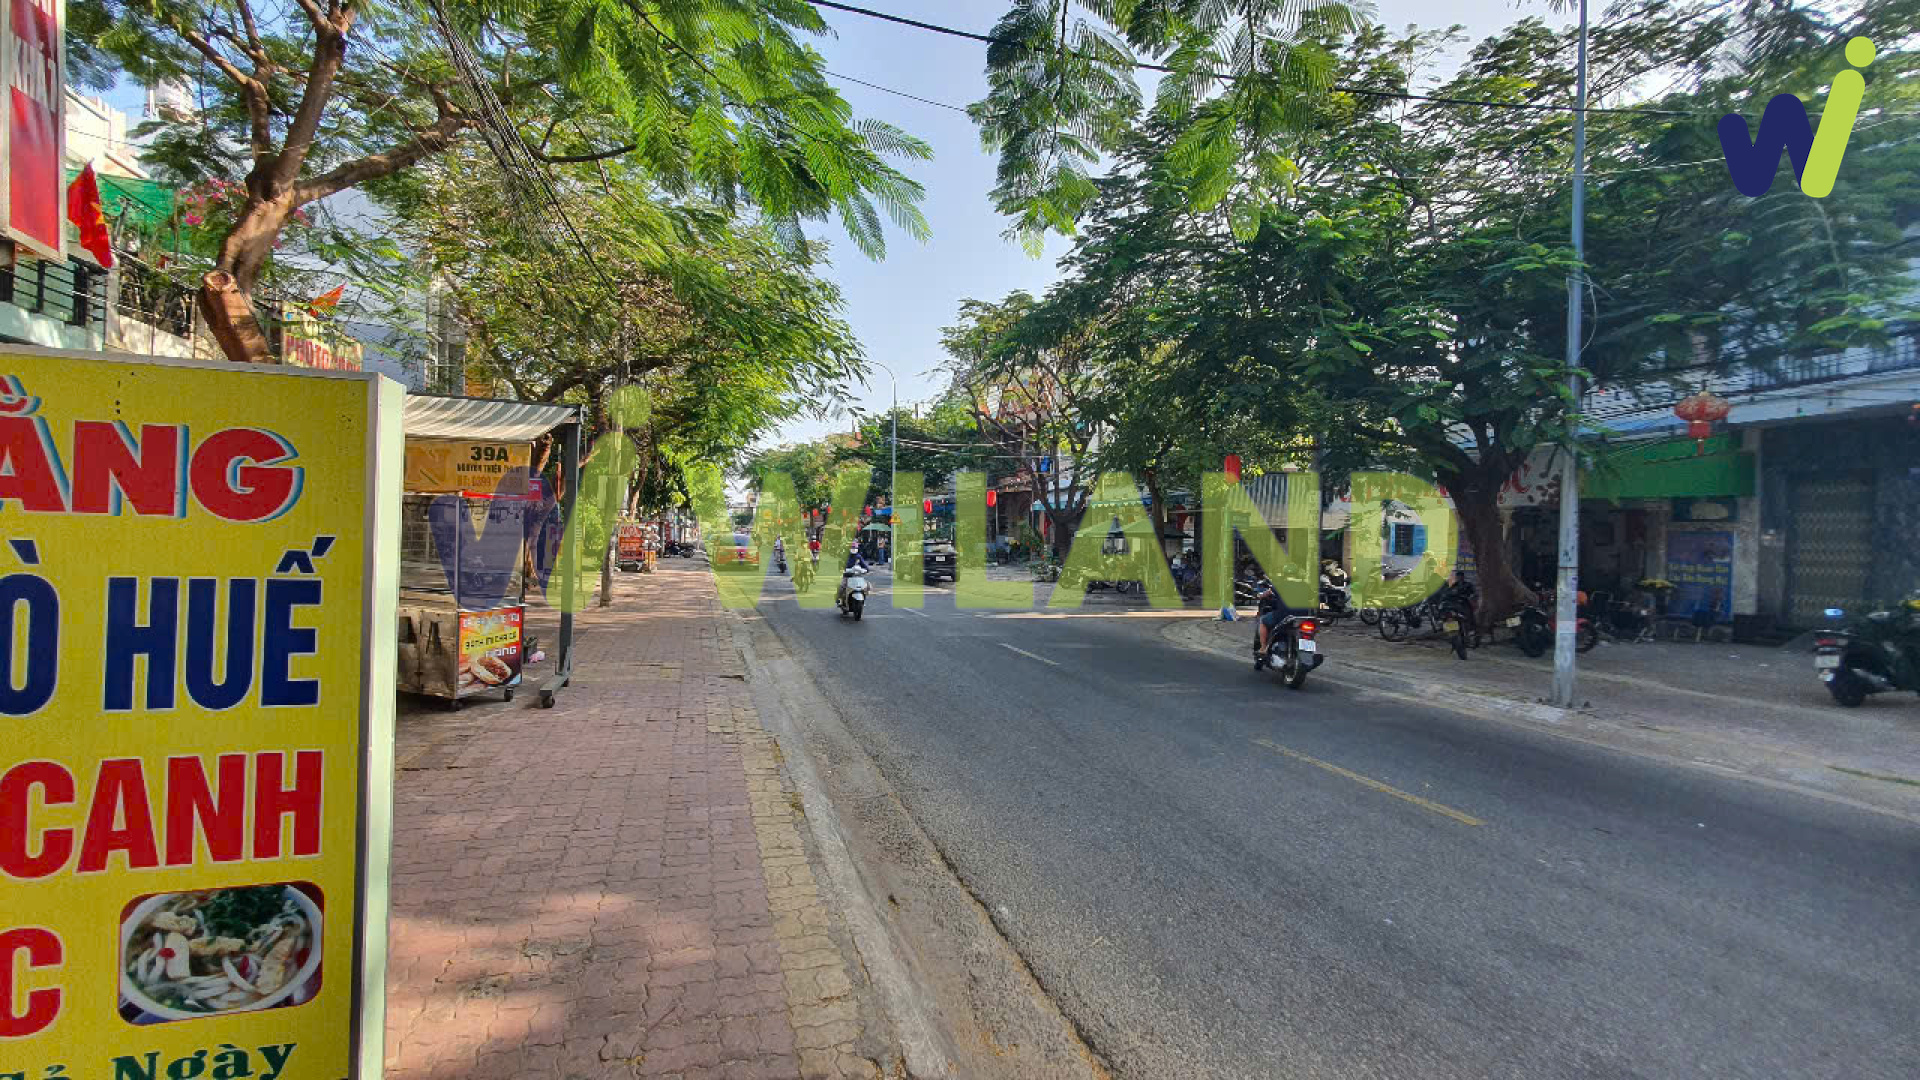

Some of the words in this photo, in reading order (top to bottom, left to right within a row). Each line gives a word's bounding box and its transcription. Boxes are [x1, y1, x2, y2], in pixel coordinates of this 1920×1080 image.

[470, 446, 509, 462] 39A
[103, 536, 336, 711] HUẾ
[0, 749, 325, 880] CANH
